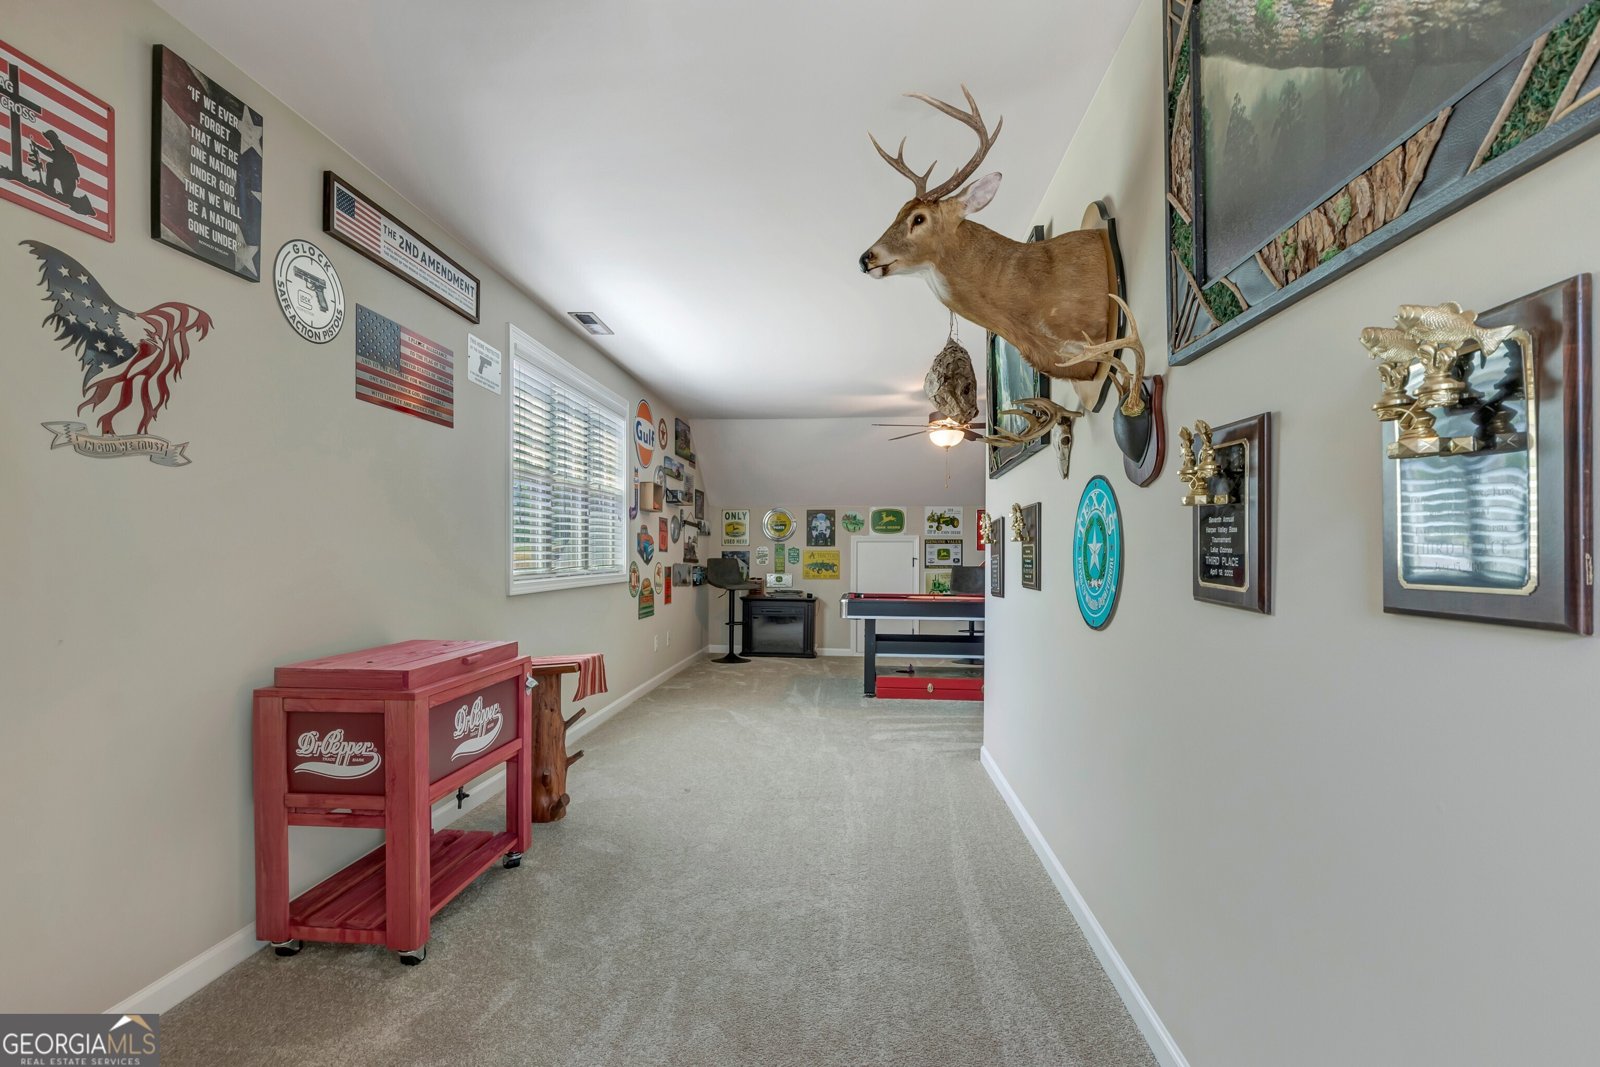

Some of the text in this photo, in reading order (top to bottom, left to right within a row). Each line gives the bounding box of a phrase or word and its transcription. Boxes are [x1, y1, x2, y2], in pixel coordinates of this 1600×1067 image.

[1, 96, 36, 123] CROSS
[200, 112, 230, 141] FORGET
[203, 95, 216, 114] WE
[218, 106, 239, 129] EVER
[190, 124, 238, 165] THAT WE'RE
[191, 145, 237, 182] ONE NATION
[191, 163, 216, 188] UNDER
[185, 178, 242, 219] THEN WE WILL
[188, 199, 238, 235] BE A NATION
[188, 218, 209, 239] GONE
[292, 243, 332, 273] GLOCK
[383, 225, 474, 297] THE 2ND AMENDMENT
[277, 280, 342, 340] SAFE-ACTION PISTOLS
[83, 440, 164, 452] IN GOD WE TRUST
[636, 421, 654, 447] Gulf
[724, 511, 747, 520] ONLY
[1078, 491, 1115, 537] TEXAS
[1205, 556, 1239, 566] THIRD PLACE
[453, 696, 501, 739] Dr Pepper
[296, 729, 374, 766] Dr Pepper
